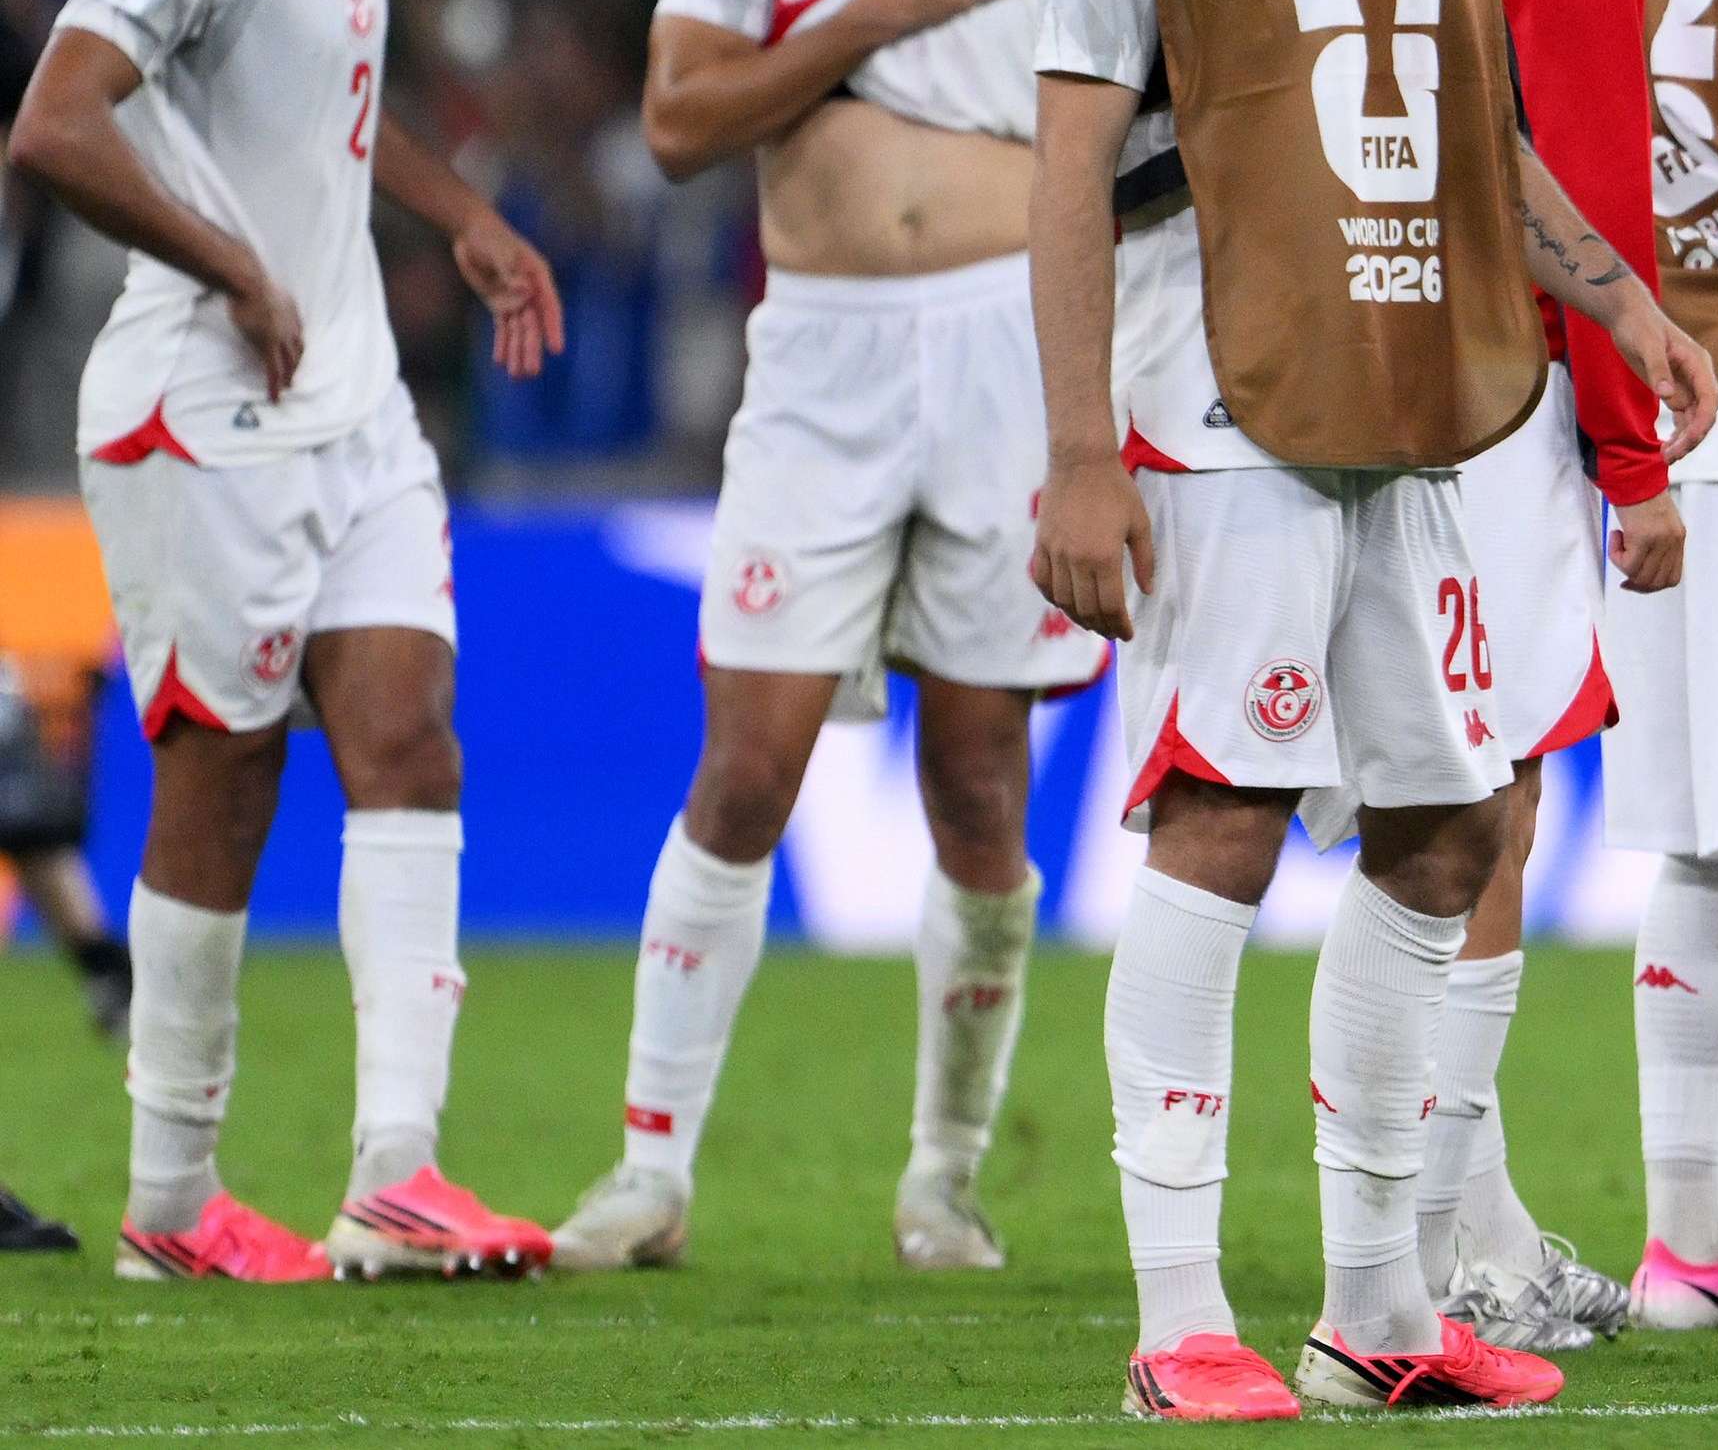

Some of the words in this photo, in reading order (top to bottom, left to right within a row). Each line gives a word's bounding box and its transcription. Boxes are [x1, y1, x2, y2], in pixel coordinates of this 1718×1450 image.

[1361, 135, 1419, 170] FIFA
[1337, 217, 1403, 247] WORLD
[1345, 253, 1443, 304] 2026
[1438, 575, 1492, 692] 26
